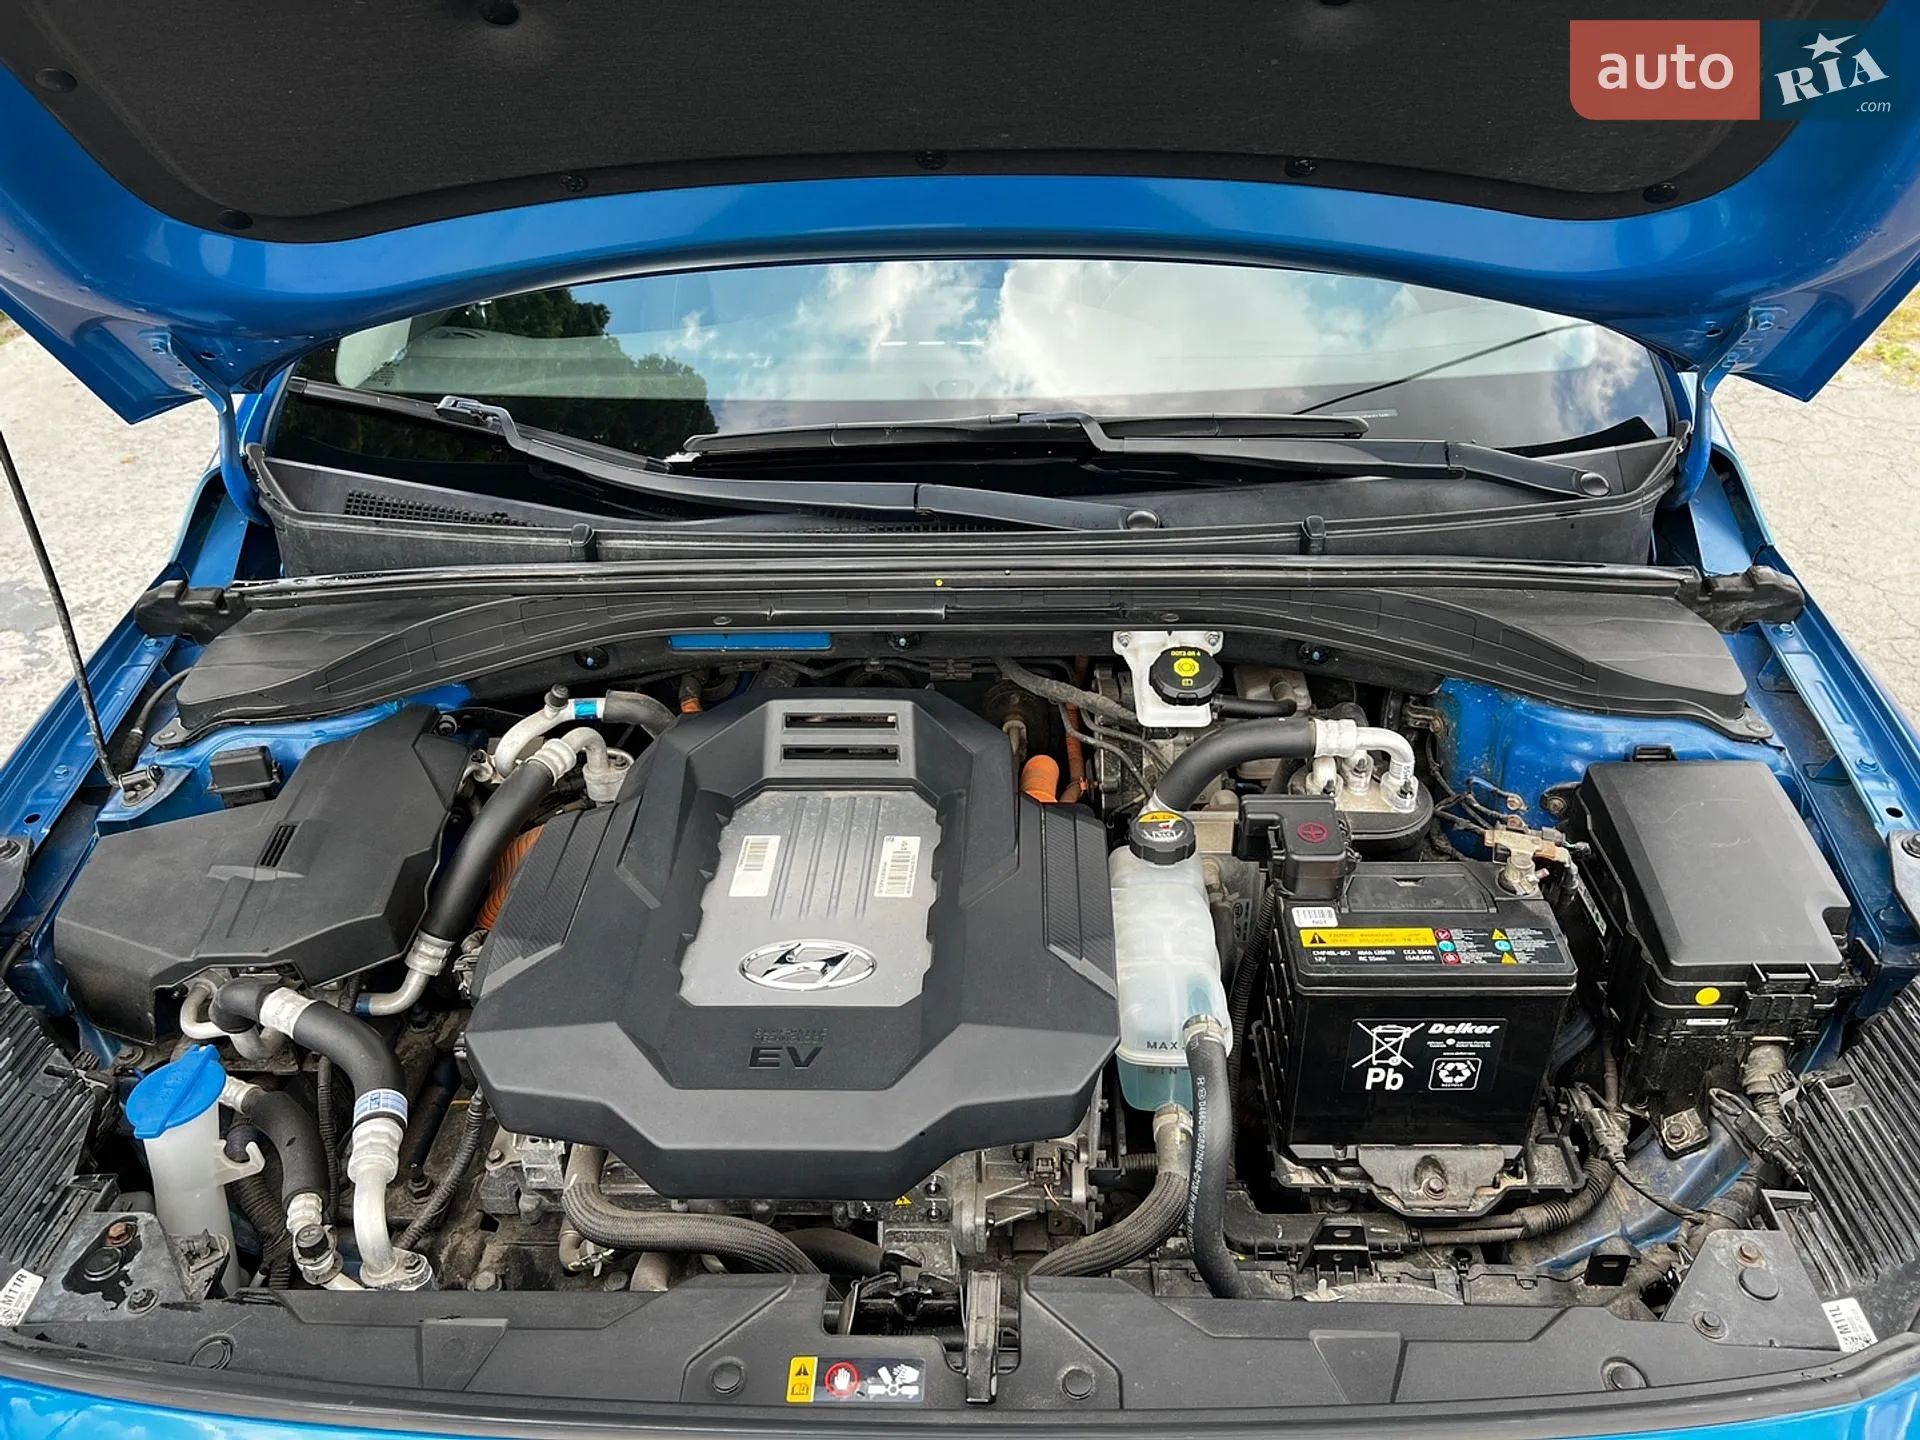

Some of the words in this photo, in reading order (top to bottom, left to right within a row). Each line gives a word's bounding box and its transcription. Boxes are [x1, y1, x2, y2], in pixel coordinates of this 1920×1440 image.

[1428, 1022, 1500, 1035] Delkor
[1147, 1041, 1178, 1050] MAX
[749, 1046, 823, 1068] EV
[1365, 1067, 1404, 1091] Pb
